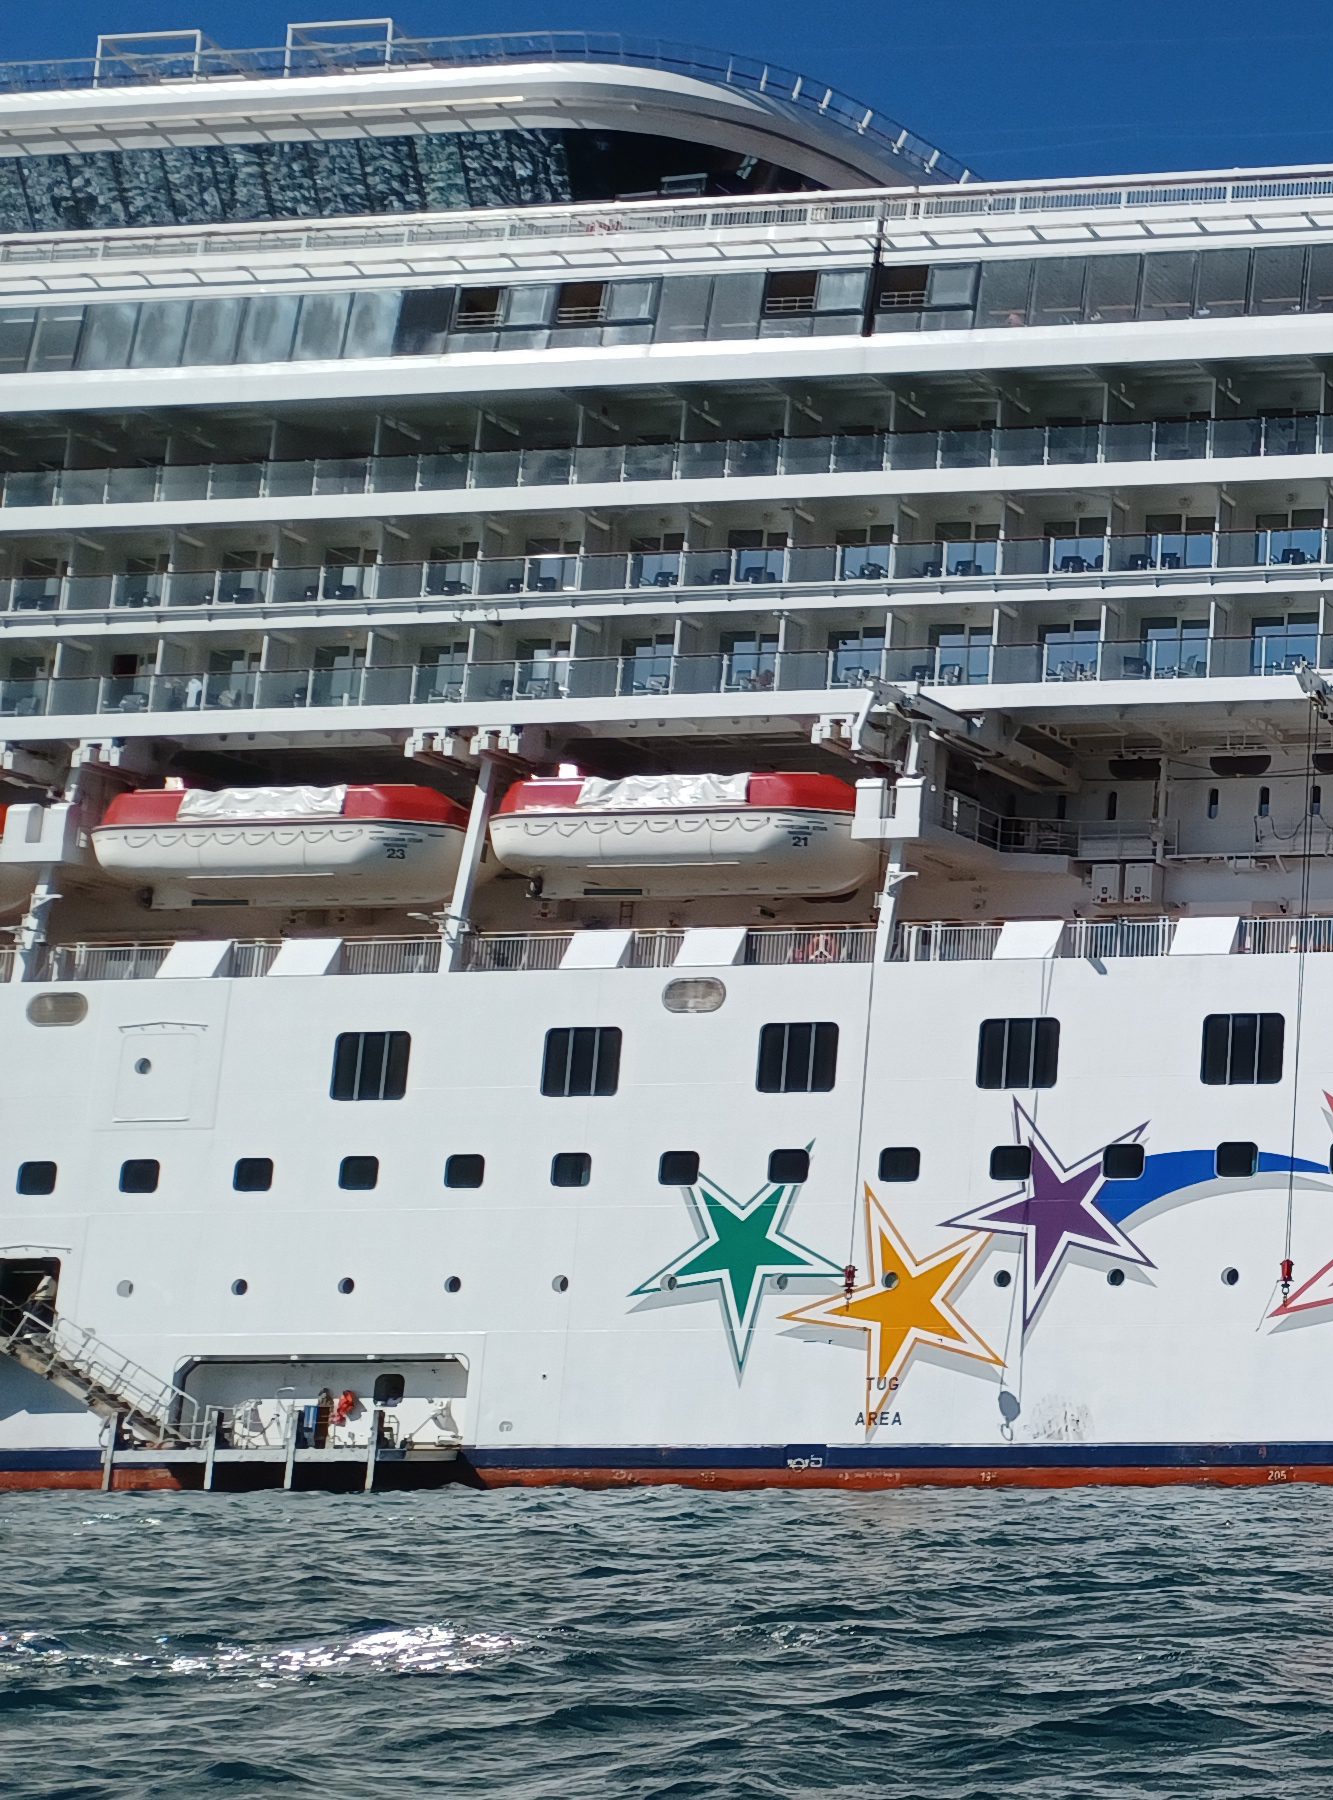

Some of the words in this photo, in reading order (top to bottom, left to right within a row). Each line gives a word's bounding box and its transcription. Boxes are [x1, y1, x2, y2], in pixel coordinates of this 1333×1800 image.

[791, 836, 808, 847] 21
[386, 848, 406, 859] 23
[866, 1376, 900, 1391] TUG
[854, 1411, 902, 1426] AREA
[1267, 1470, 1287, 1481] 205
